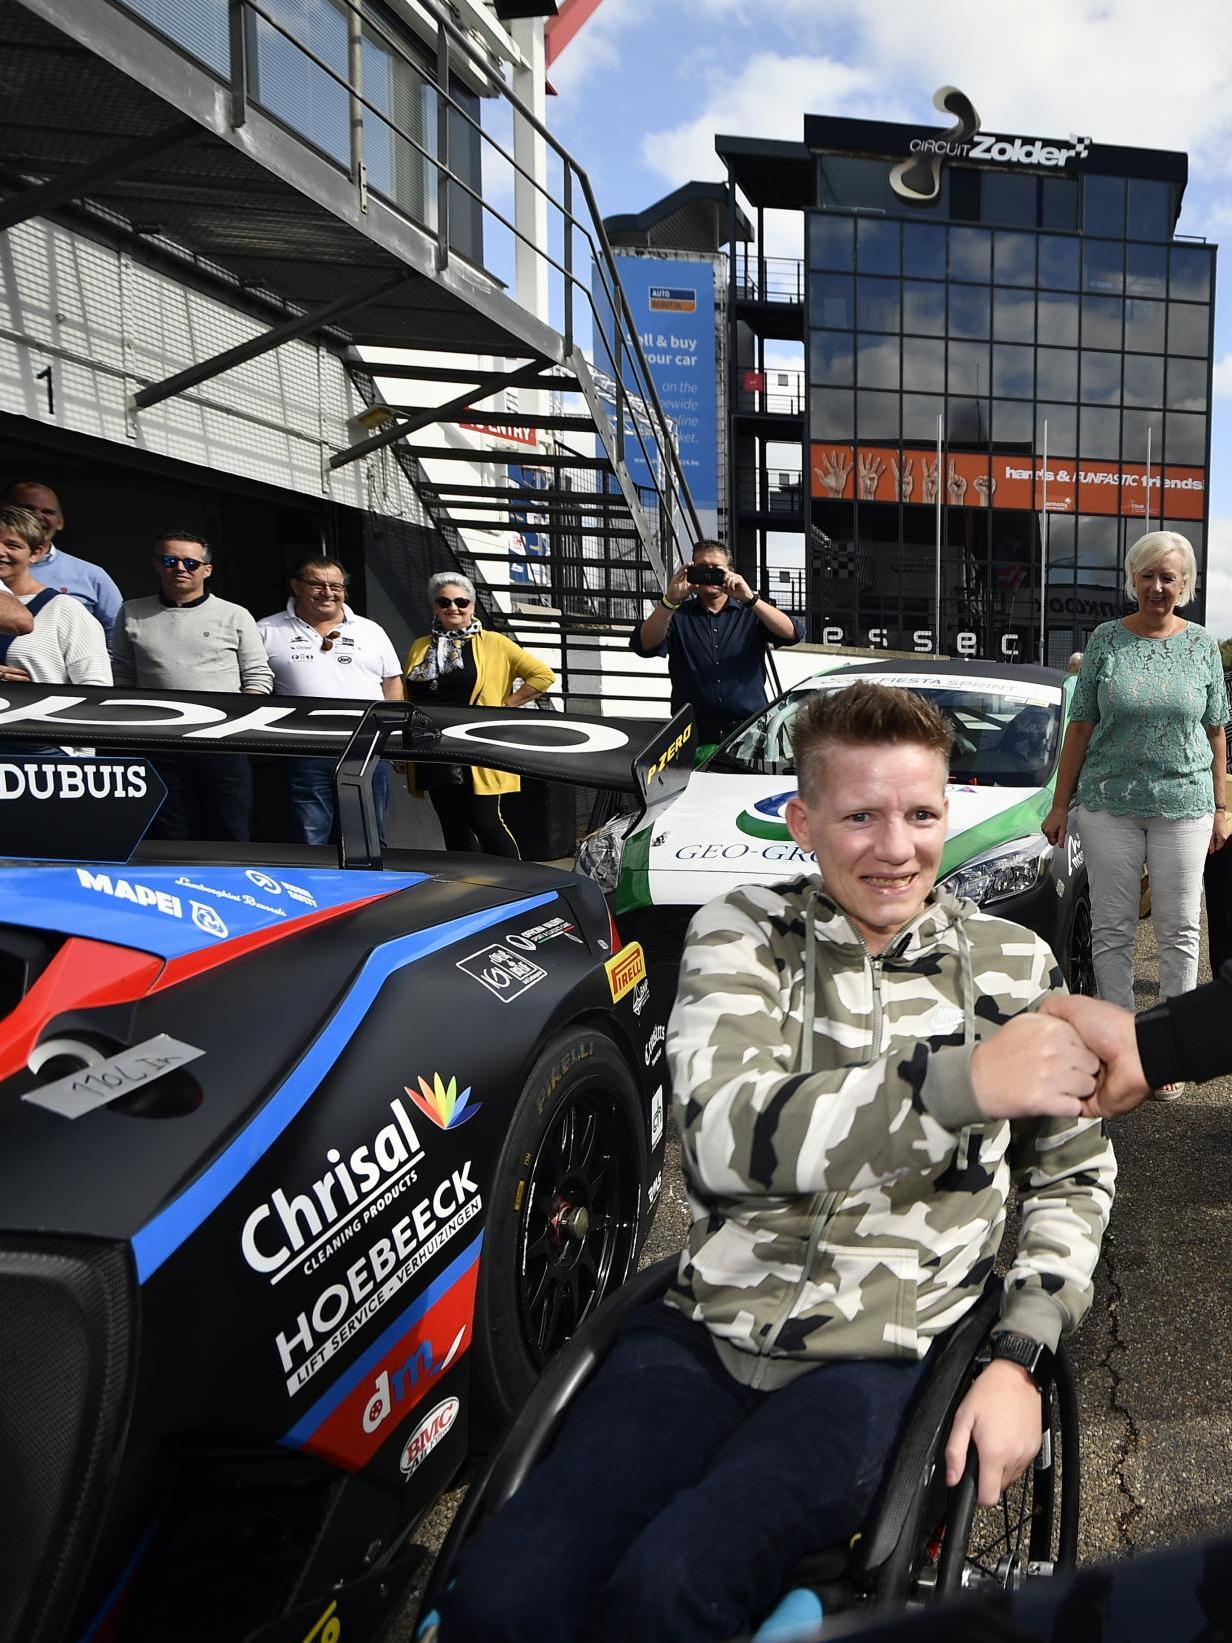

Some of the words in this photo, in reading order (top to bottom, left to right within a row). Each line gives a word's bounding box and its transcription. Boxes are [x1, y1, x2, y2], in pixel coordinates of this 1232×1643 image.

[910, 138, 971, 158] CIRCUIT
[969, 135, 1075, 166] Zolder
[652, 289, 670, 298] AUTO
[643, 354, 672, 365] our
[675, 355, 698, 366] car
[656, 335, 667, 347] &
[670, 335, 697, 352] buy
[36, 365, 55, 415] 1
[679, 381, 699, 393] the
[1056, 470, 1071, 482] &
[1073, 471, 1138, 486] FUNFASTIC
[878, 676, 941, 685] FIESTA
[658, 724, 692, 773] ZERO
[0, 764, 148, 800] DUBUIS
[76, 868, 183, 918] MAPEI
[611, 948, 643, 994] PIRELLI
[241, 1098, 421, 1273] Chrisal
[303, 1221, 362, 1276] CLEANING
[363, 1170, 419, 1225] PRODUCTS
[275, 1160, 479, 1374] HOEBEECK
[296, 1350, 327, 1385] LIFT
[331, 1291, 386, 1349] SERVICE
[396, 1200, 480, 1285] VERHUIZINGEN
[405, 1403, 454, 1466] BMC
